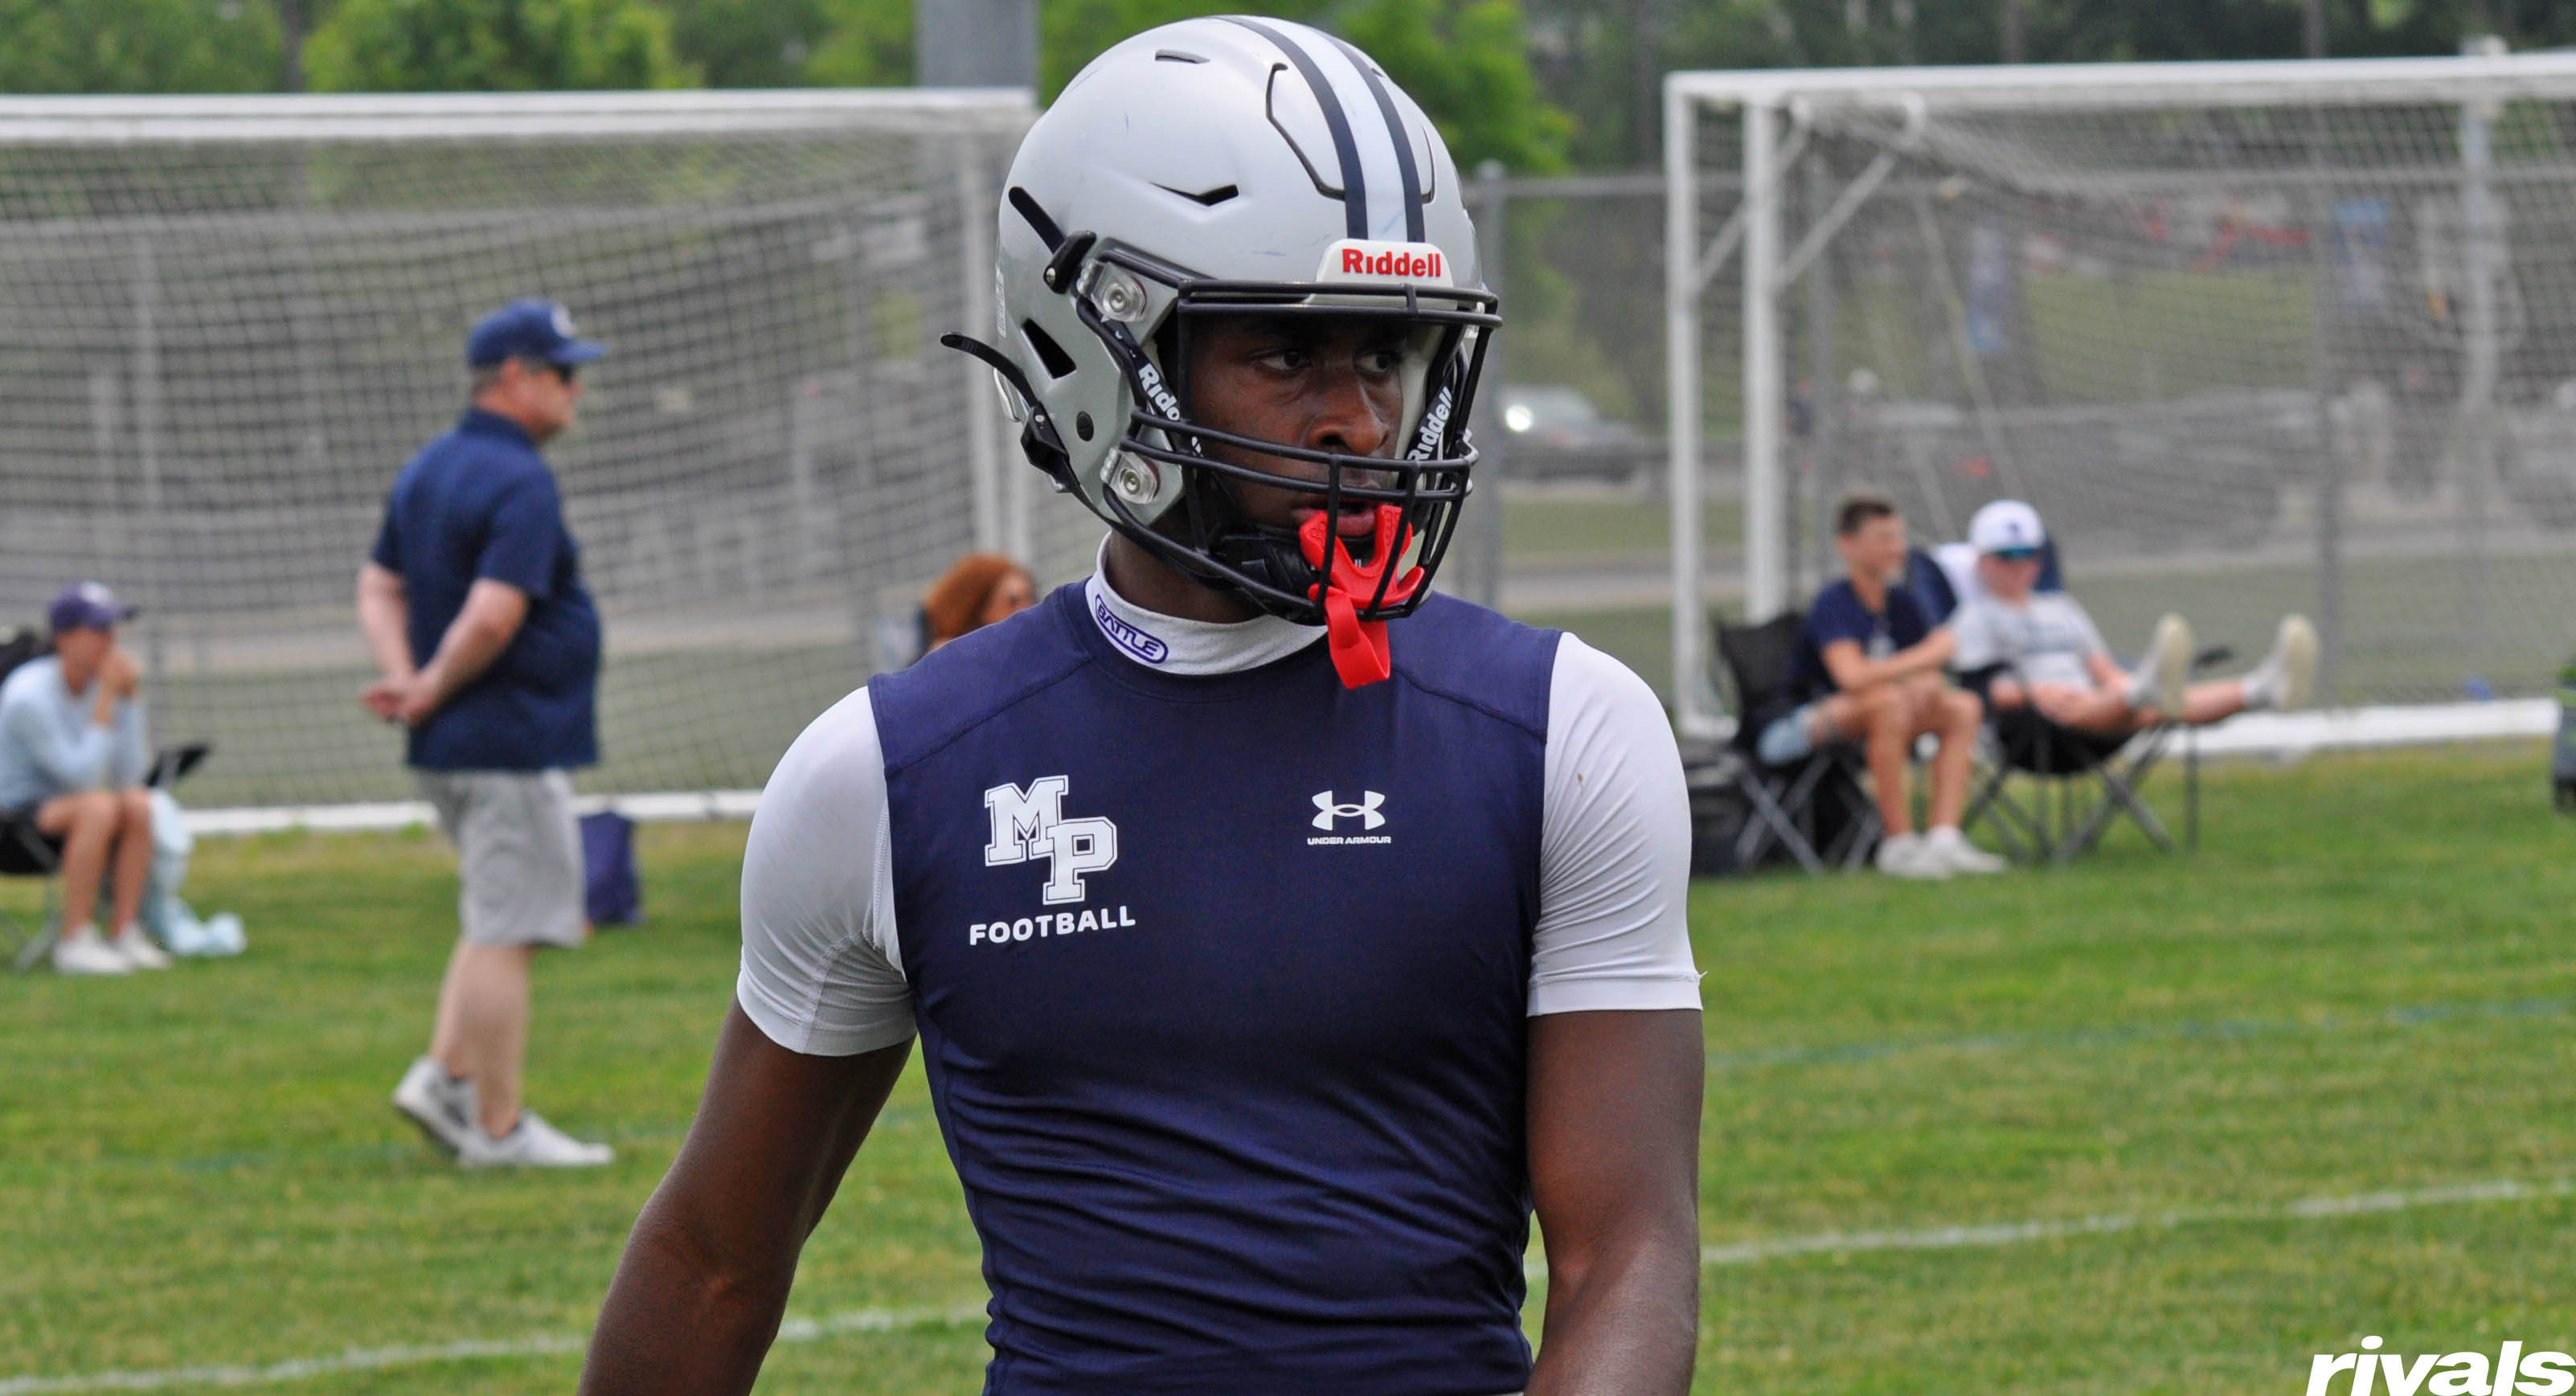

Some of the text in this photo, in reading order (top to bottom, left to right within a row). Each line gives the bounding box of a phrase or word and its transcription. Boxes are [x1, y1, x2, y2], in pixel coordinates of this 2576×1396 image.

[1342, 248, 1441, 277] Riddell
[1097, 604, 1160, 657] BATTLE
[984, 774, 1118, 906] MP
[1307, 836, 1391, 845] UNDER ARMOUR
[969, 906, 1136, 946] FOOTBALL
